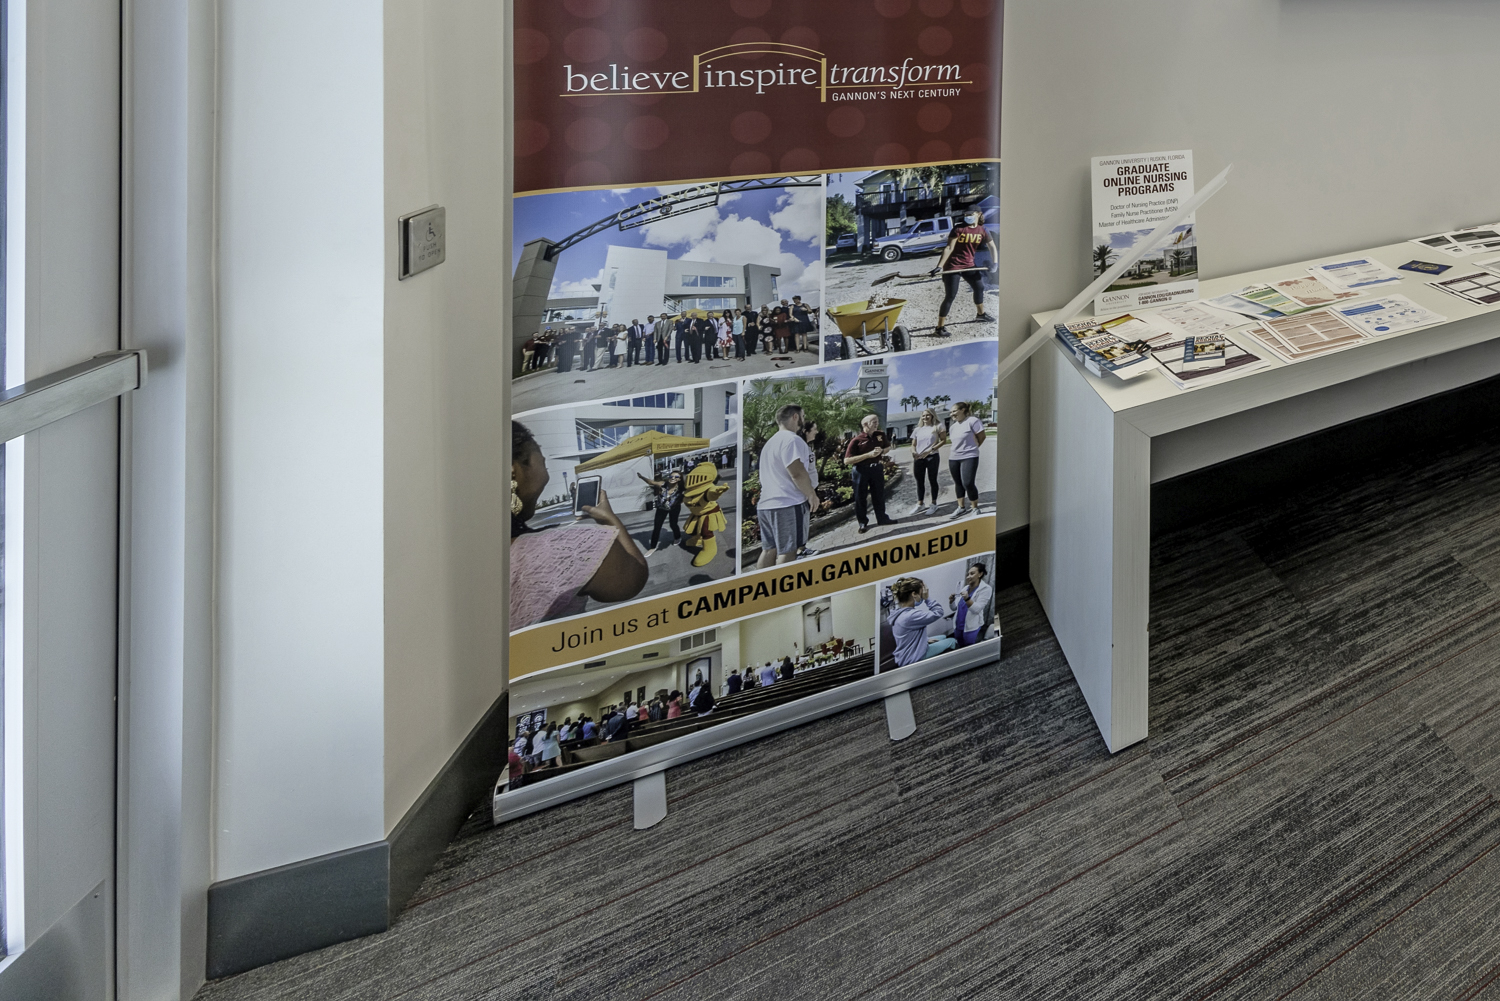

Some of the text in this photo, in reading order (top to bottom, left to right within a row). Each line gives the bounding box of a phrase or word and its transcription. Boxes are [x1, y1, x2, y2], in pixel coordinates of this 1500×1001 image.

[563, 57, 962, 95] believe inspire transform
[831, 88, 962, 102] GANNON'S NEXT CENTURY
[1099, 159, 1120, 167] GANNON
[1120, 157, 1147, 165] UNIVERSITY
[1117, 162, 1170, 176] GRADUATE
[1103, 171, 1188, 188] ONLINE NURSING
[1118, 182, 1175, 197] PROGRAMS
[617, 181, 719, 221] GANNON
[1131, 200, 1149, 209] Nursing
[1149, 199, 1166, 207] Practice
[1110, 211, 1126, 219] Family
[1126, 209, 1140, 217] Nurse
[1140, 207, 1164, 215] Practitioner
[1121, 216, 1145, 225] Healthcare
[957, 233, 982, 244] GIVE
[1102, 293, 1130, 304] GANNON
[551, 529, 969, 653] Join us at CAMPAIGN.GANNON.EDU
